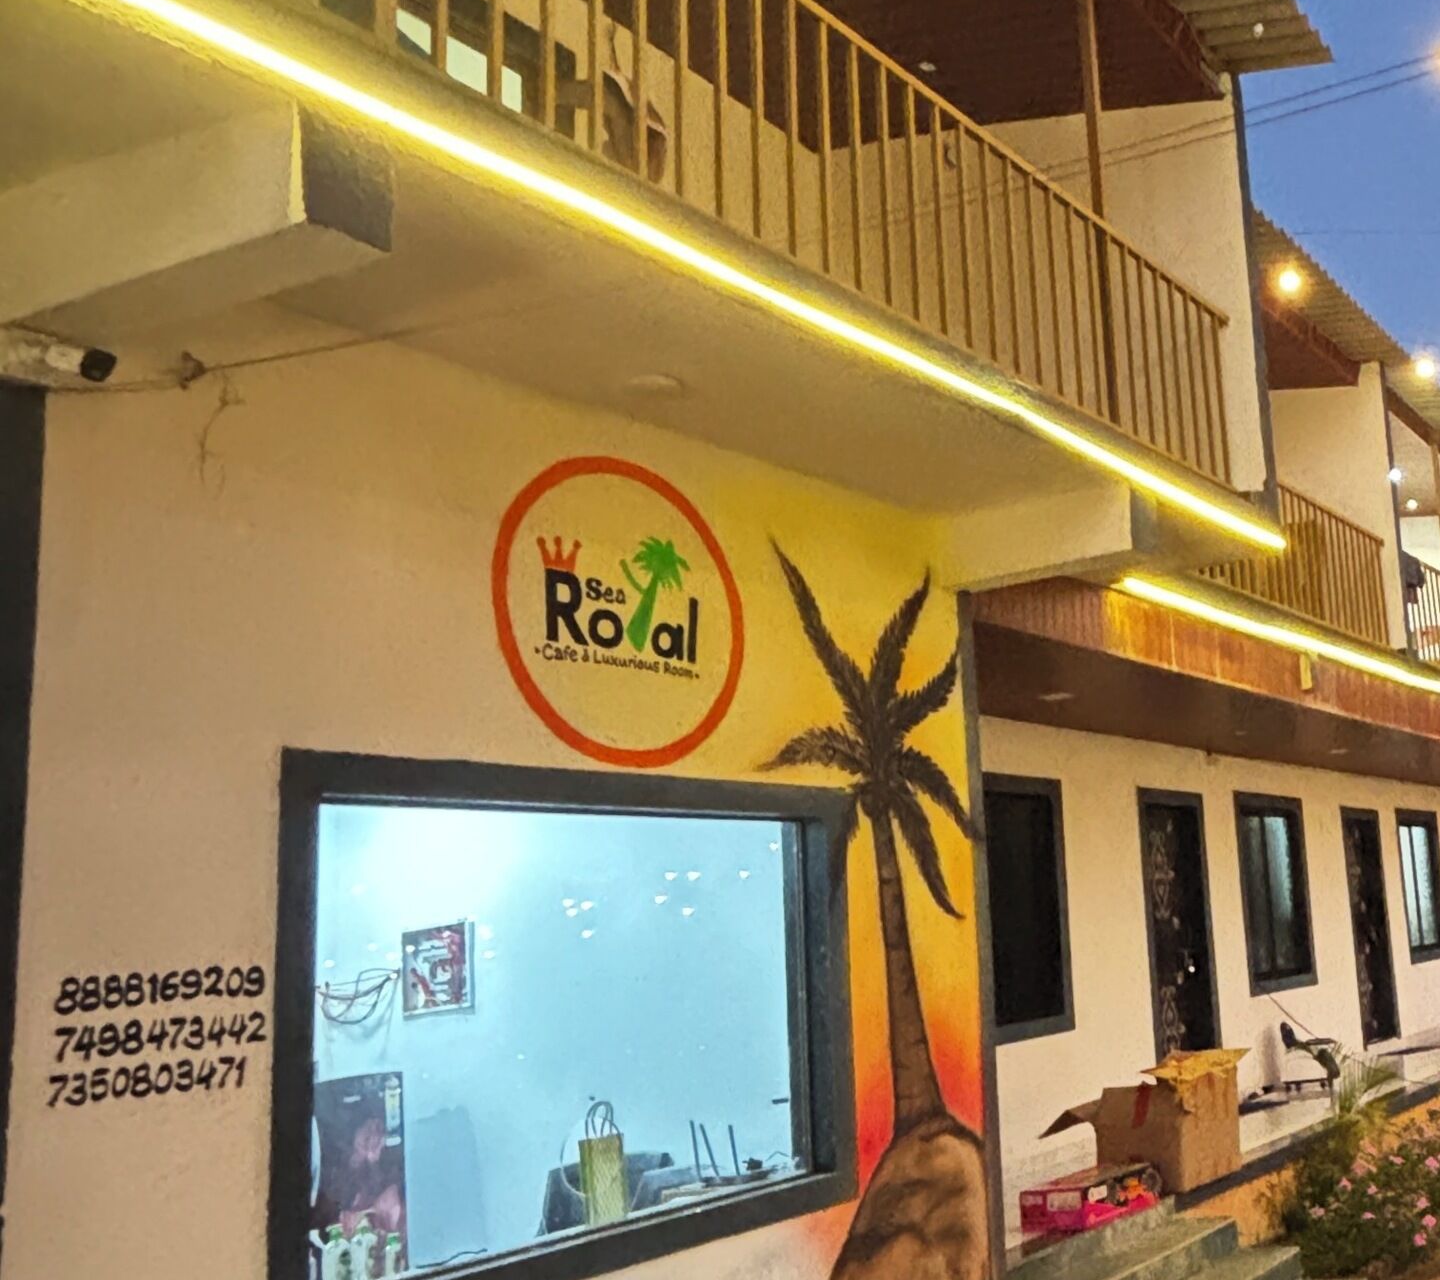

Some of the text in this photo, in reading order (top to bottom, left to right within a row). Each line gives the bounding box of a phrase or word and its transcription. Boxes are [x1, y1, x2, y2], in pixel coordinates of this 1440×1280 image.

[545, 550, 699, 664] Royal
[585, 577, 626, 605] Sea
[542, 643, 578, 663] Cafe
[593, 650, 660, 673] Luxurious
[663, 661, 694, 680] Room
[54, 965, 266, 1015] 8888169209
[54, 1011, 268, 1063] 7498473442
[46, 1055, 247, 1108] 7350803471
